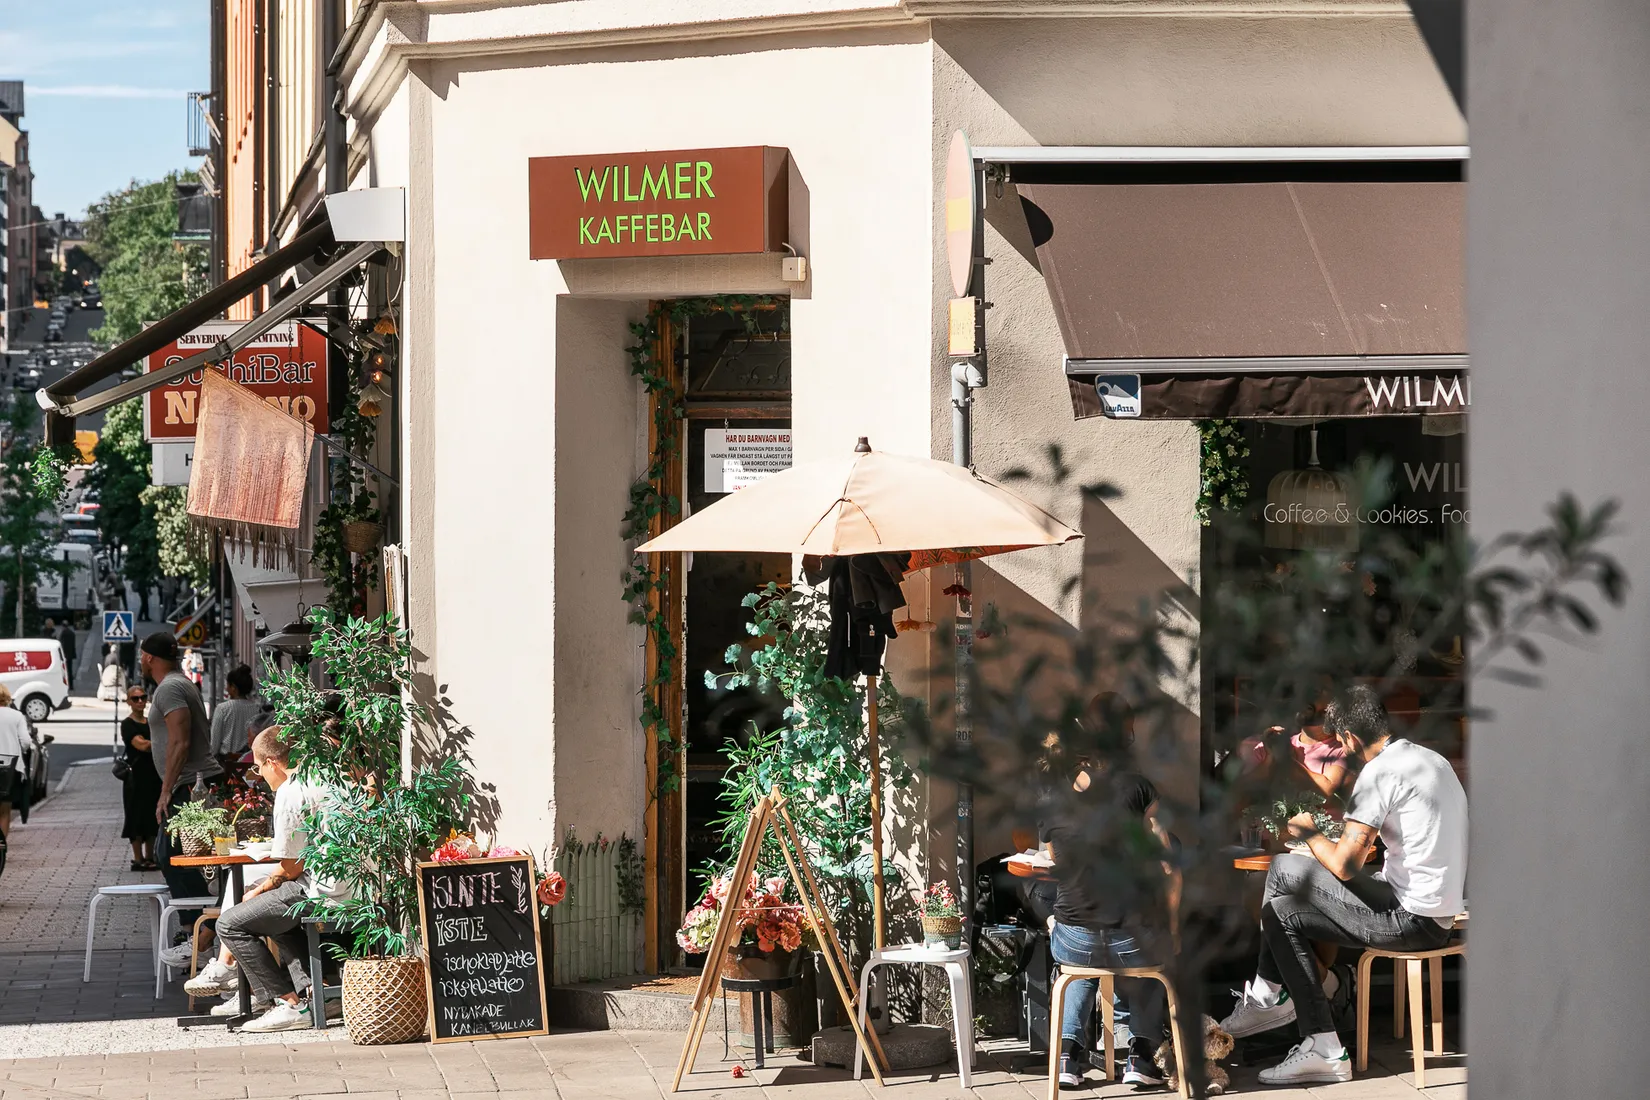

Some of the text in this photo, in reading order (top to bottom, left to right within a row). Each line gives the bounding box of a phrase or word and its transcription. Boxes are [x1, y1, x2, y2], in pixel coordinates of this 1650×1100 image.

[574, 161, 715, 203] WILMER
[579, 212, 712, 244] KAFFEBAR
[1363, 375, 1471, 408] WILM
[1264, 503, 1328, 524] Coffee
[1334, 503, 1350, 524] &
[1356, 503, 1434, 524] Cookies.
[444, 1004, 505, 1020] NYBAKADE
[451, 1019, 534, 1036] KANELBULLAR
